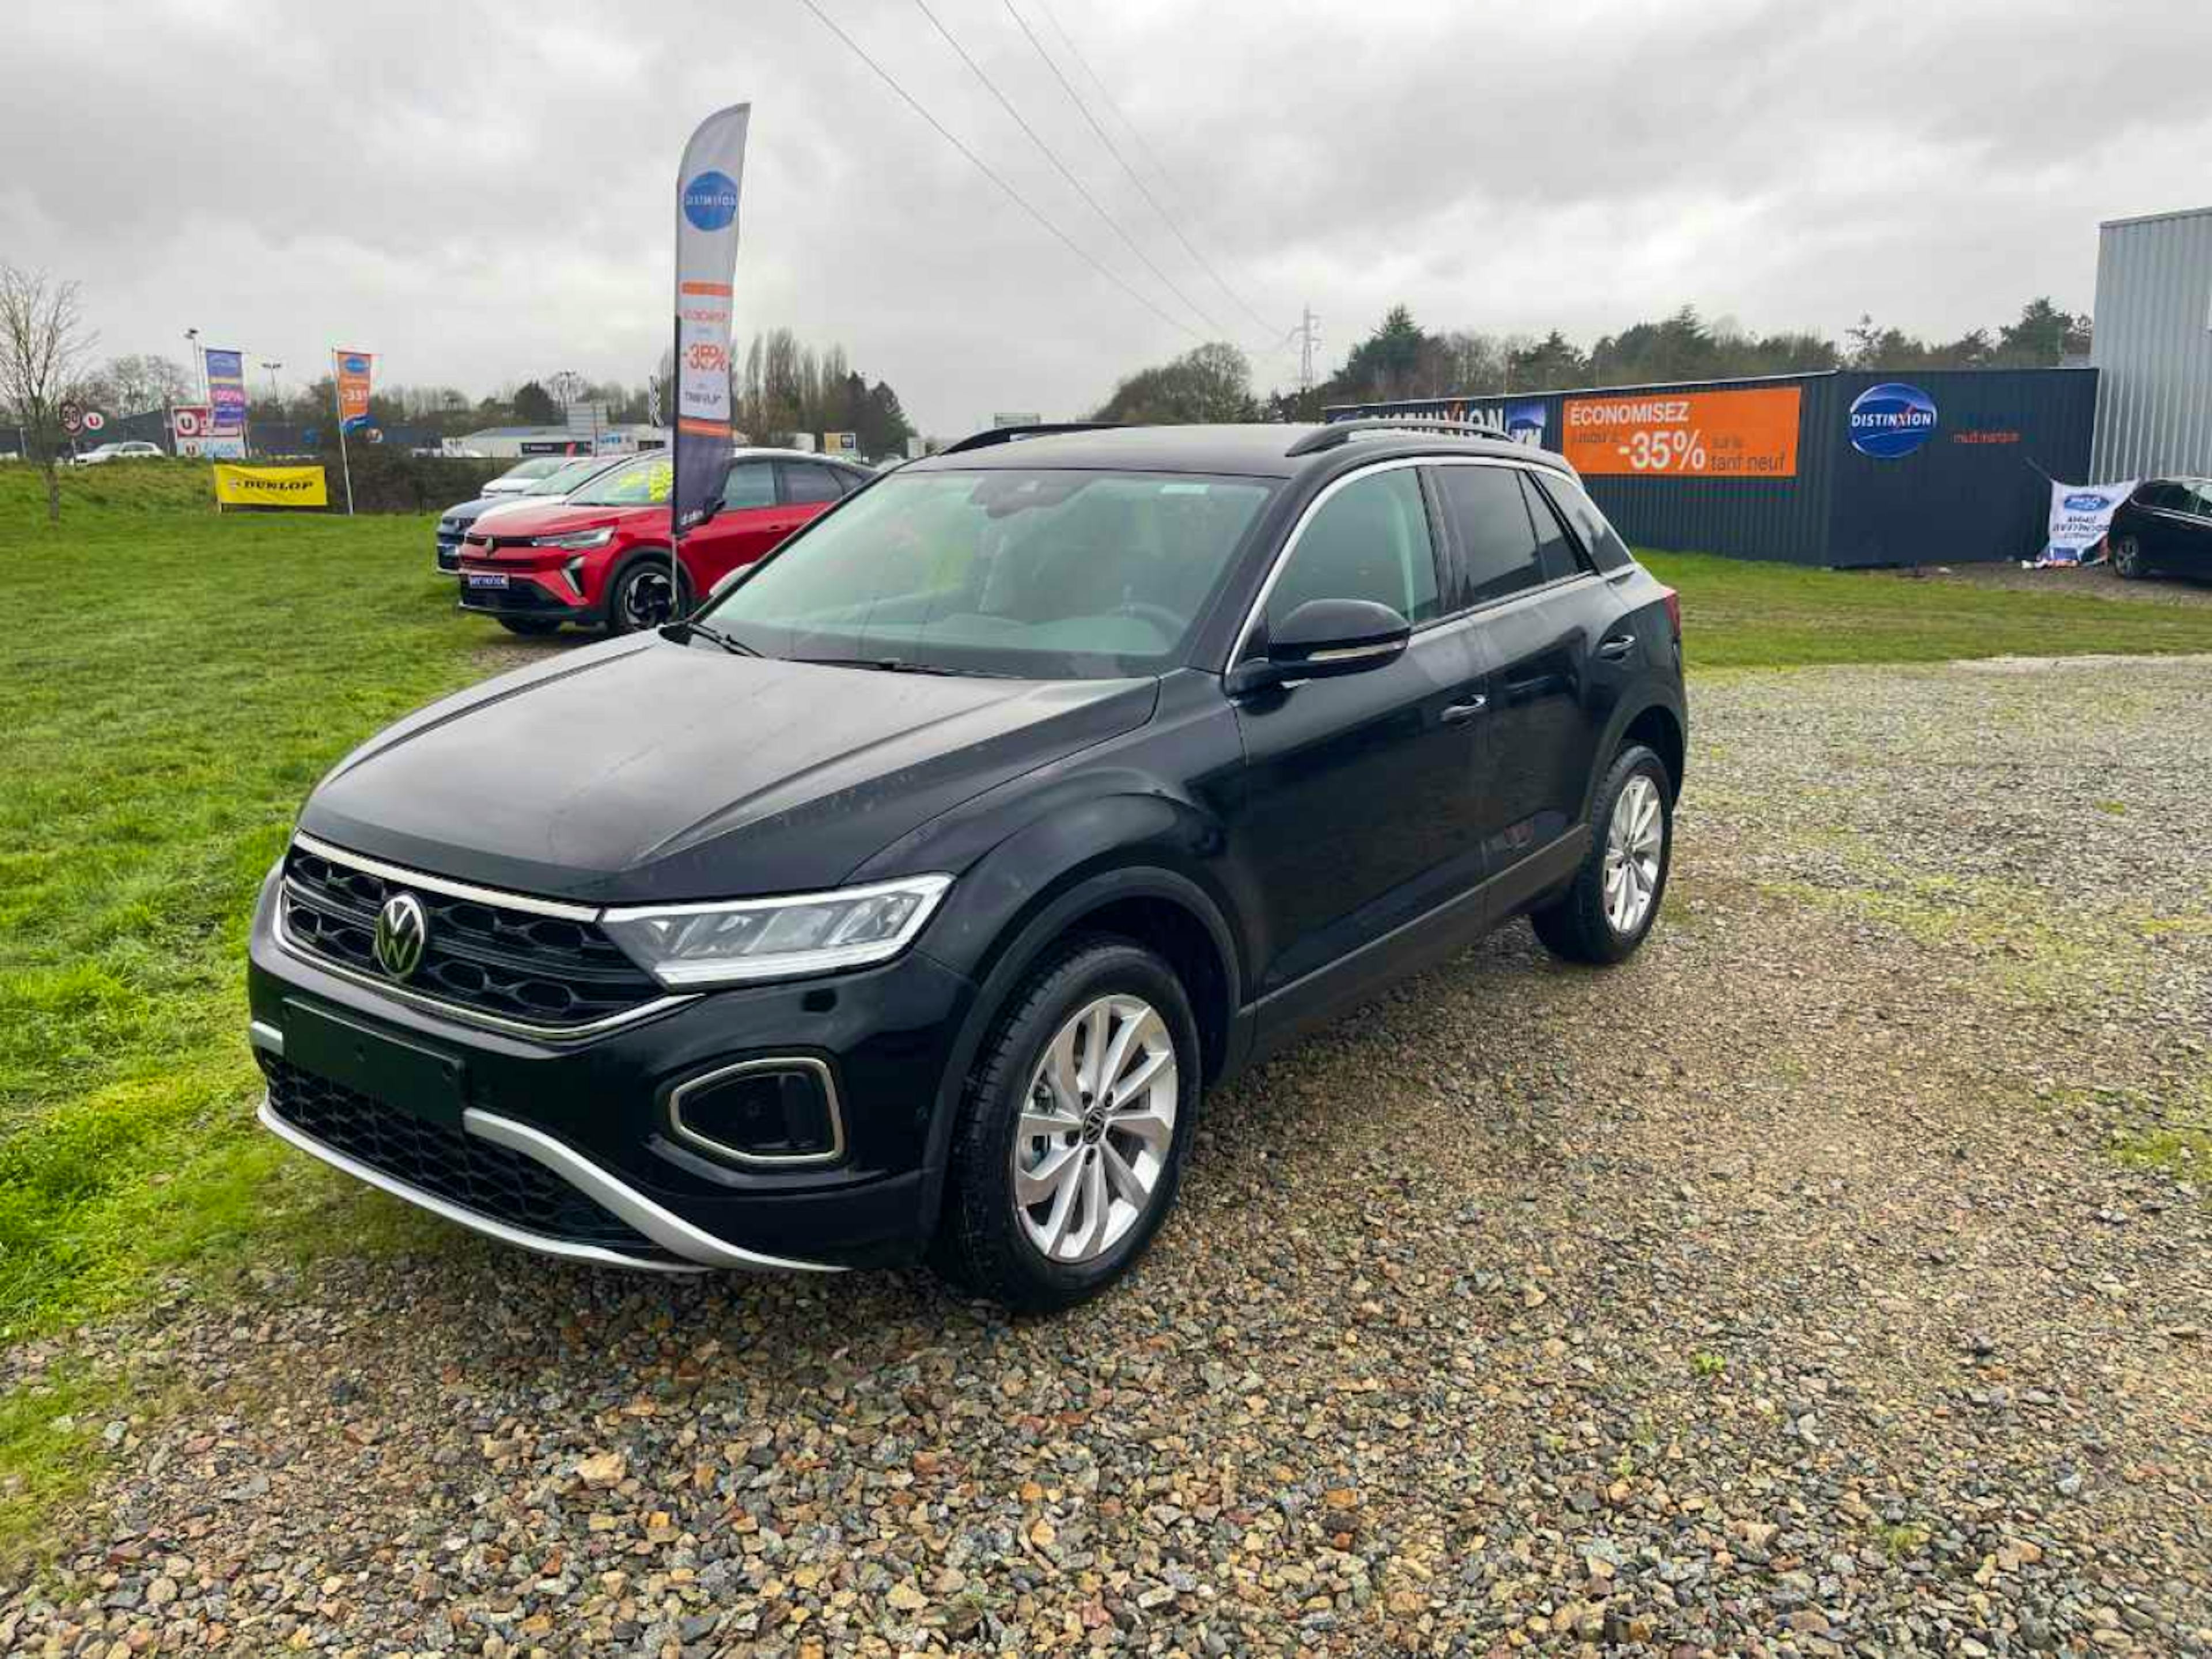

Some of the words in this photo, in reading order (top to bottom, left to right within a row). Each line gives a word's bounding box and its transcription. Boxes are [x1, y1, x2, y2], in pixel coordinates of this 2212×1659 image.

[1570, 401, 1690, 426] ÉCONOMISEZ
[1851, 407, 1932, 429] DISTINXION
[1618, 429, 1706, 471] -35%
[244, 479, 314, 490] DUNLOP
